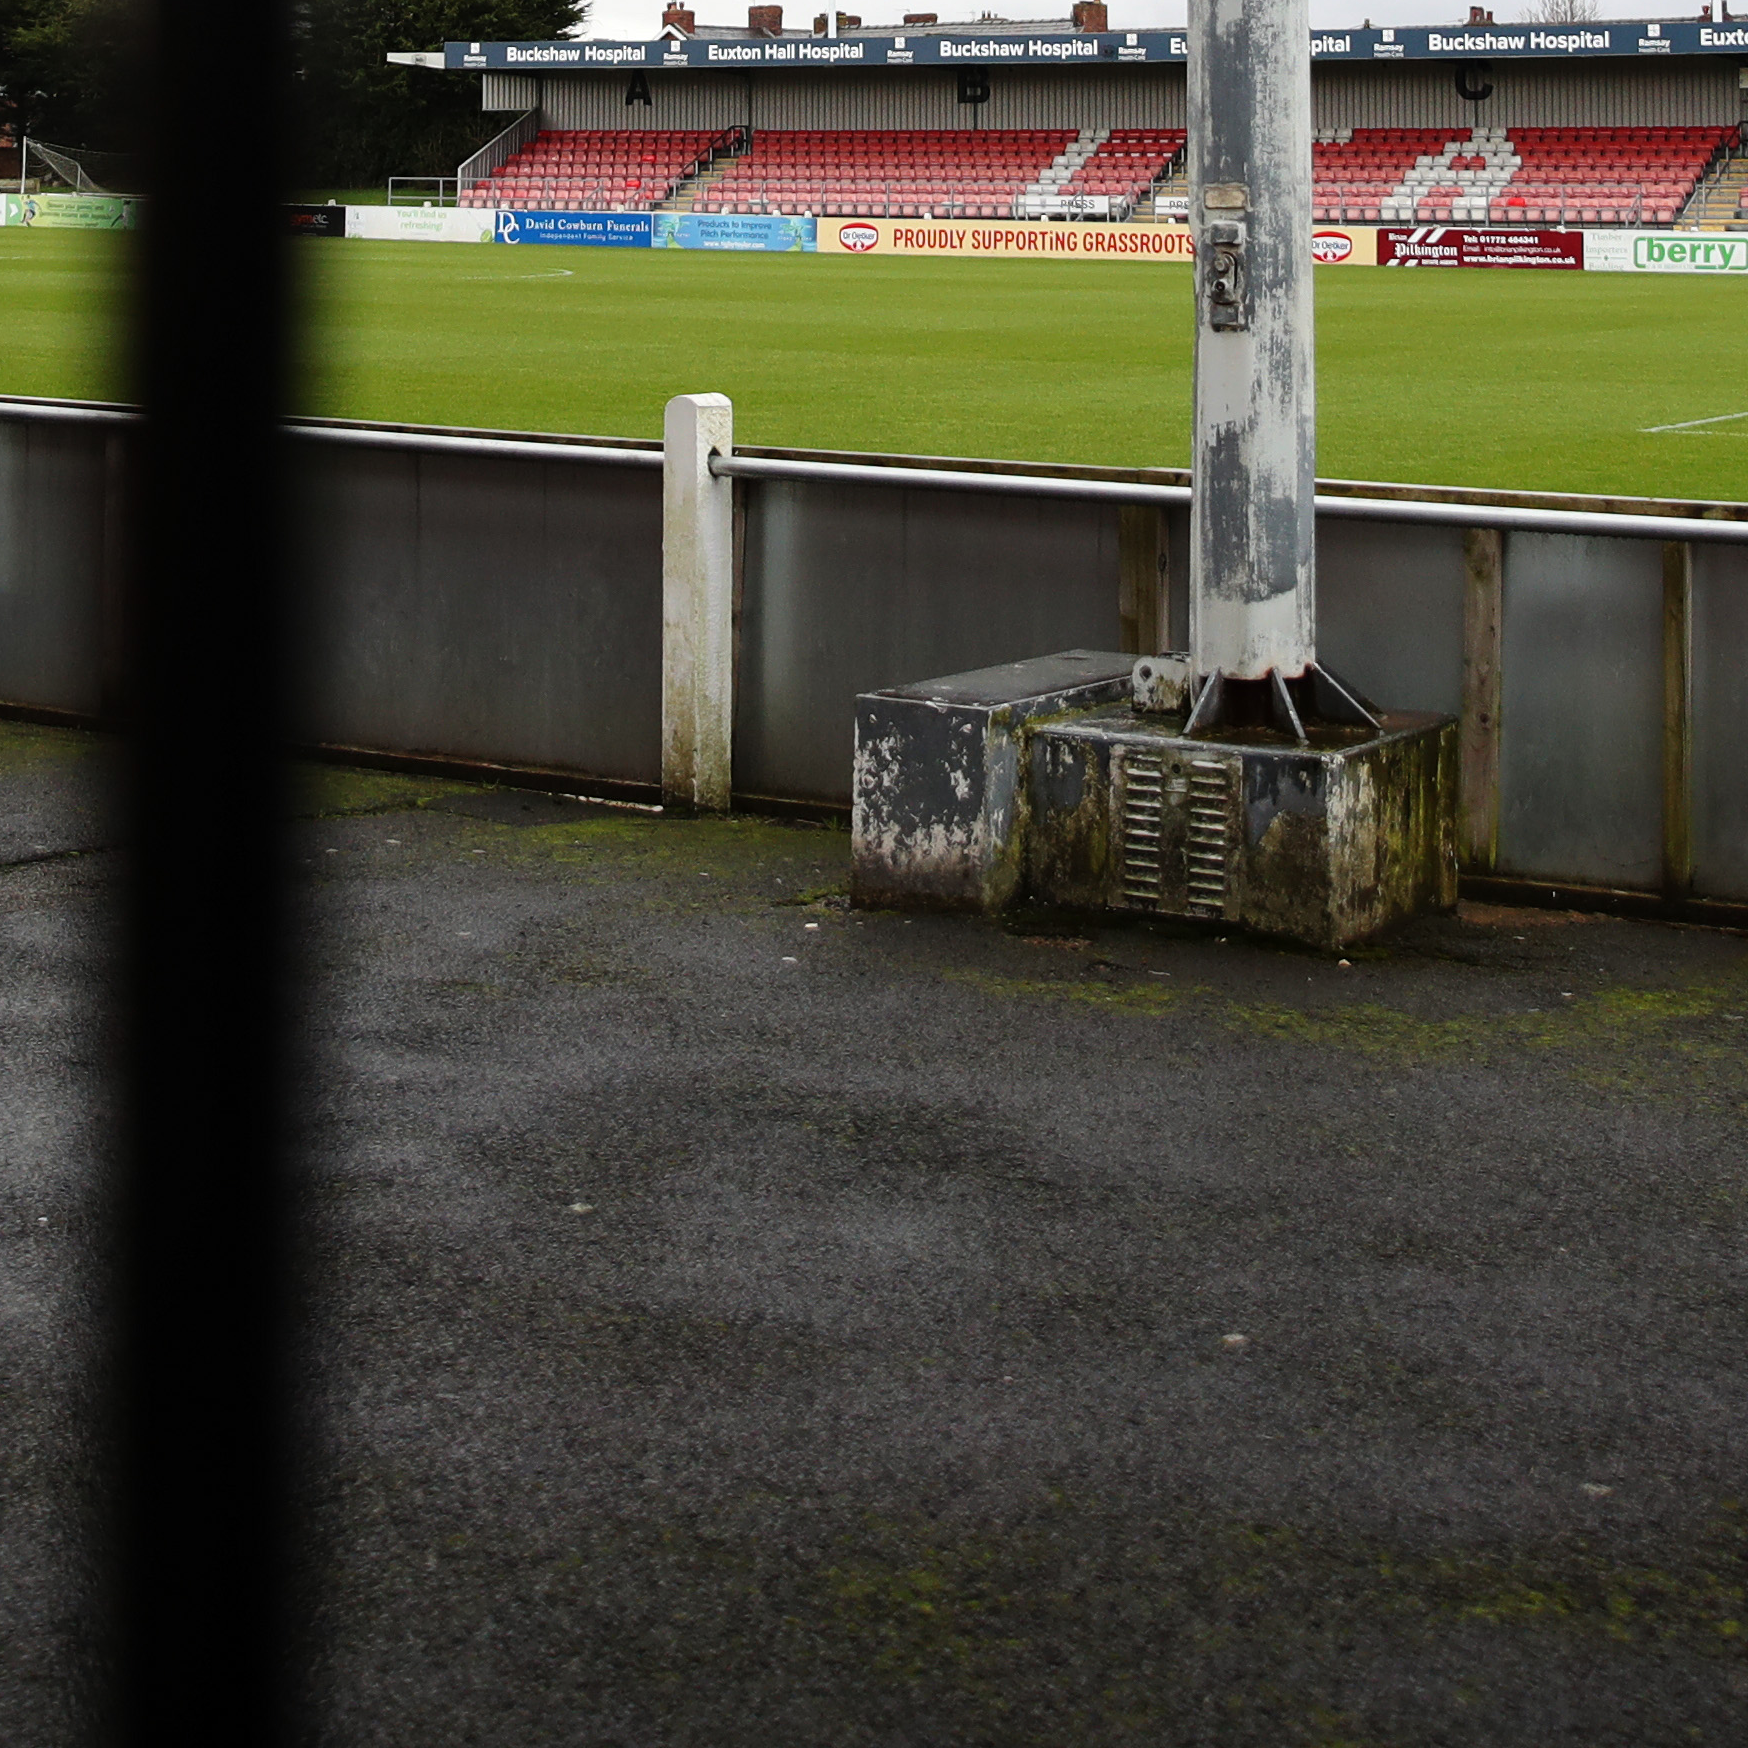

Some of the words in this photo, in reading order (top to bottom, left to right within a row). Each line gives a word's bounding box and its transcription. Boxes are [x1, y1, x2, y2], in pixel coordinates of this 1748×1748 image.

[1310, 35, 1350, 57] pital
[1429, 33, 1525, 51] Buckshaw
[1530, 31, 1610, 52] Hospital
[507, 46, 580, 62] Buckshaw
[585, 45, 645, 63] Hospital
[709, 44, 761, 60] Euxton
[765, 44, 795, 60] Hall
[799, 43, 863, 62] Hospital
[940, 40, 1024, 57] Buckshaw
[1028, 39, 1098, 59] Hospital
[957, 64, 990, 102] B
[1455, 60, 1493, 100] C
[625, 70, 652, 106] A
[1060, 199, 1095, 209] PRESS
[525, 218, 554, 229] David
[557, 219, 603, 231] Cowburn
[607, 219, 649, 232] Funerals
[698, 219, 729, 228] Products
[731, 220, 739, 228] to
[741, 220, 772, 230] Improve
[583, 233, 606, 241] Family
[700, 229, 719, 238] Pitch
[720, 230, 769, 240] Performance
[893, 228, 966, 249] PROUDLY
[971, 230, 1078, 252] SUPPORTING
[1083, 232, 1195, 254] GRASSROOTS
[1480, 236, 1506, 244] 01772
[1590, 233, 1623, 241] Timber
[1321, 241, 1348, 250] Oetker
[1394, 243, 1458, 258] Pilkington
[1586, 245, 1628, 254] Importers
[1463, 255, 1576, 264] www.brianpilkington.co.uk
[1646, 238, 1736, 269] berry
[1589, 263, 1624, 271] Building
